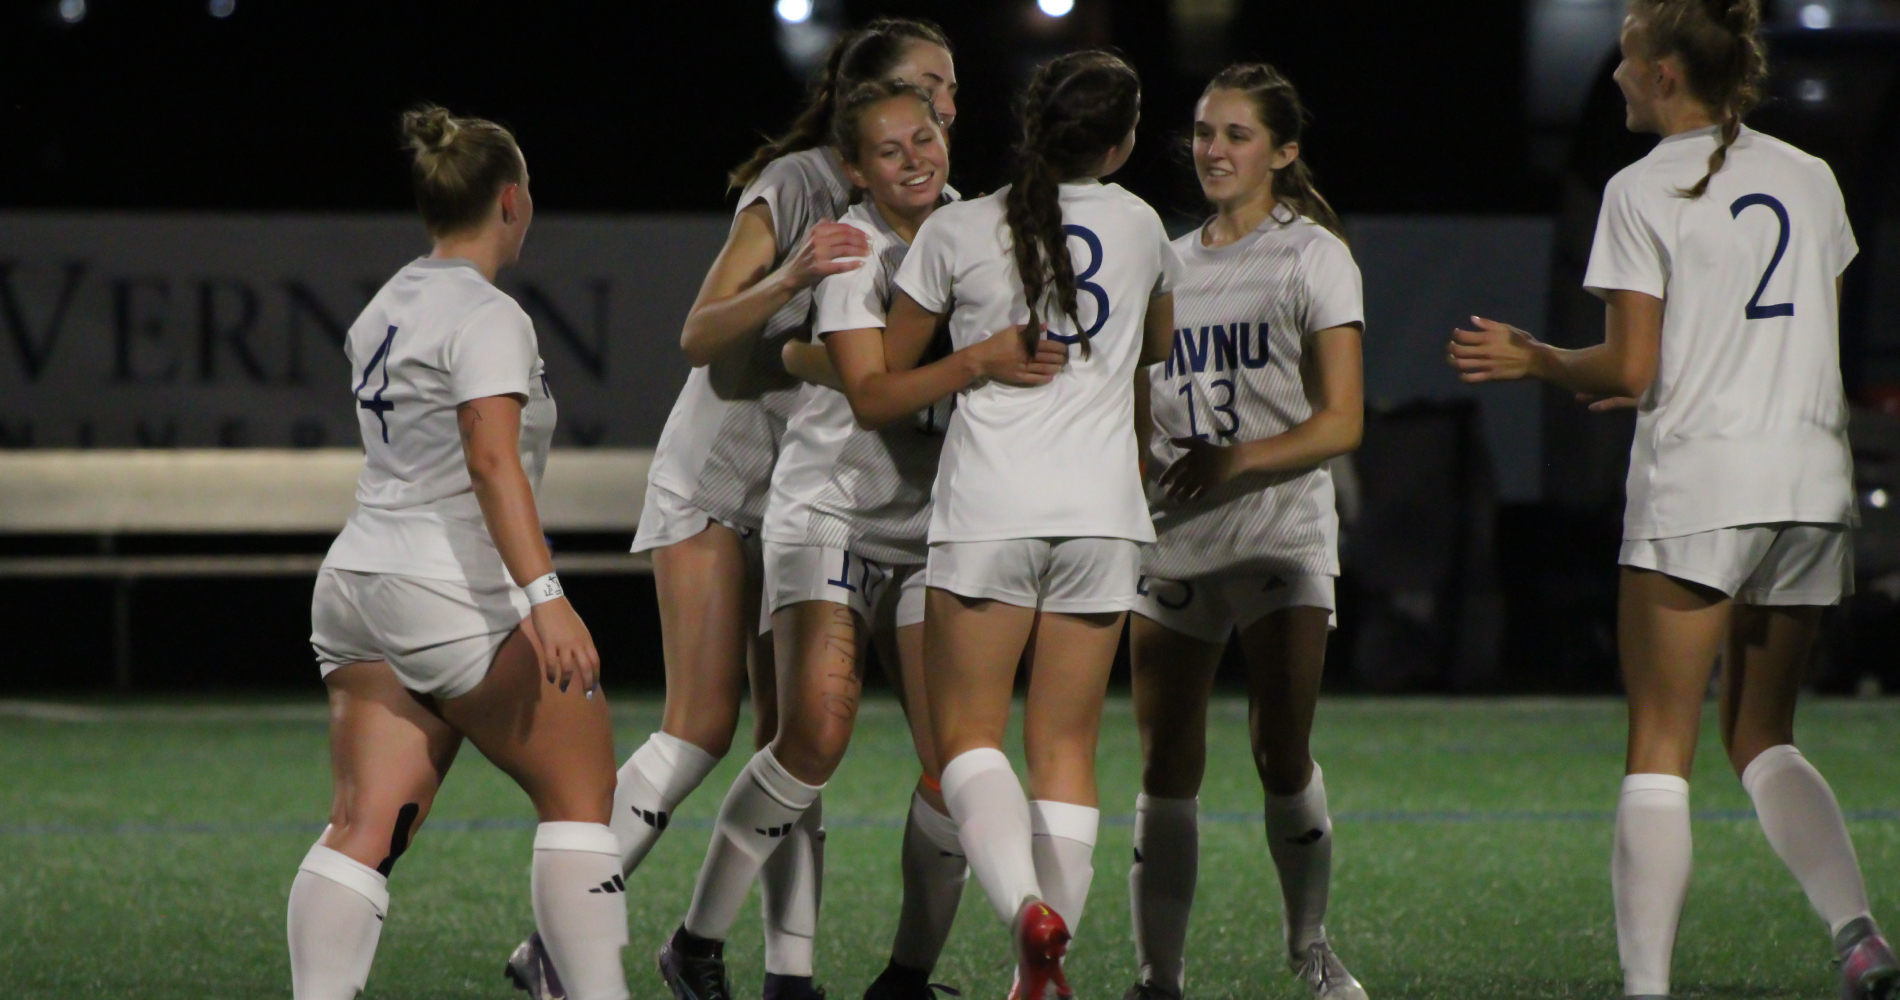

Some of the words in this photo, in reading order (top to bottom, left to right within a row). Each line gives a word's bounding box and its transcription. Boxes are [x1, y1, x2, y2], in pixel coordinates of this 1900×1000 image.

[1730, 192, 1795, 320] 2
[0, 256, 614, 384] VERNN
[354, 324, 399, 444] 4
[1178, 378, 1240, 440] 13
